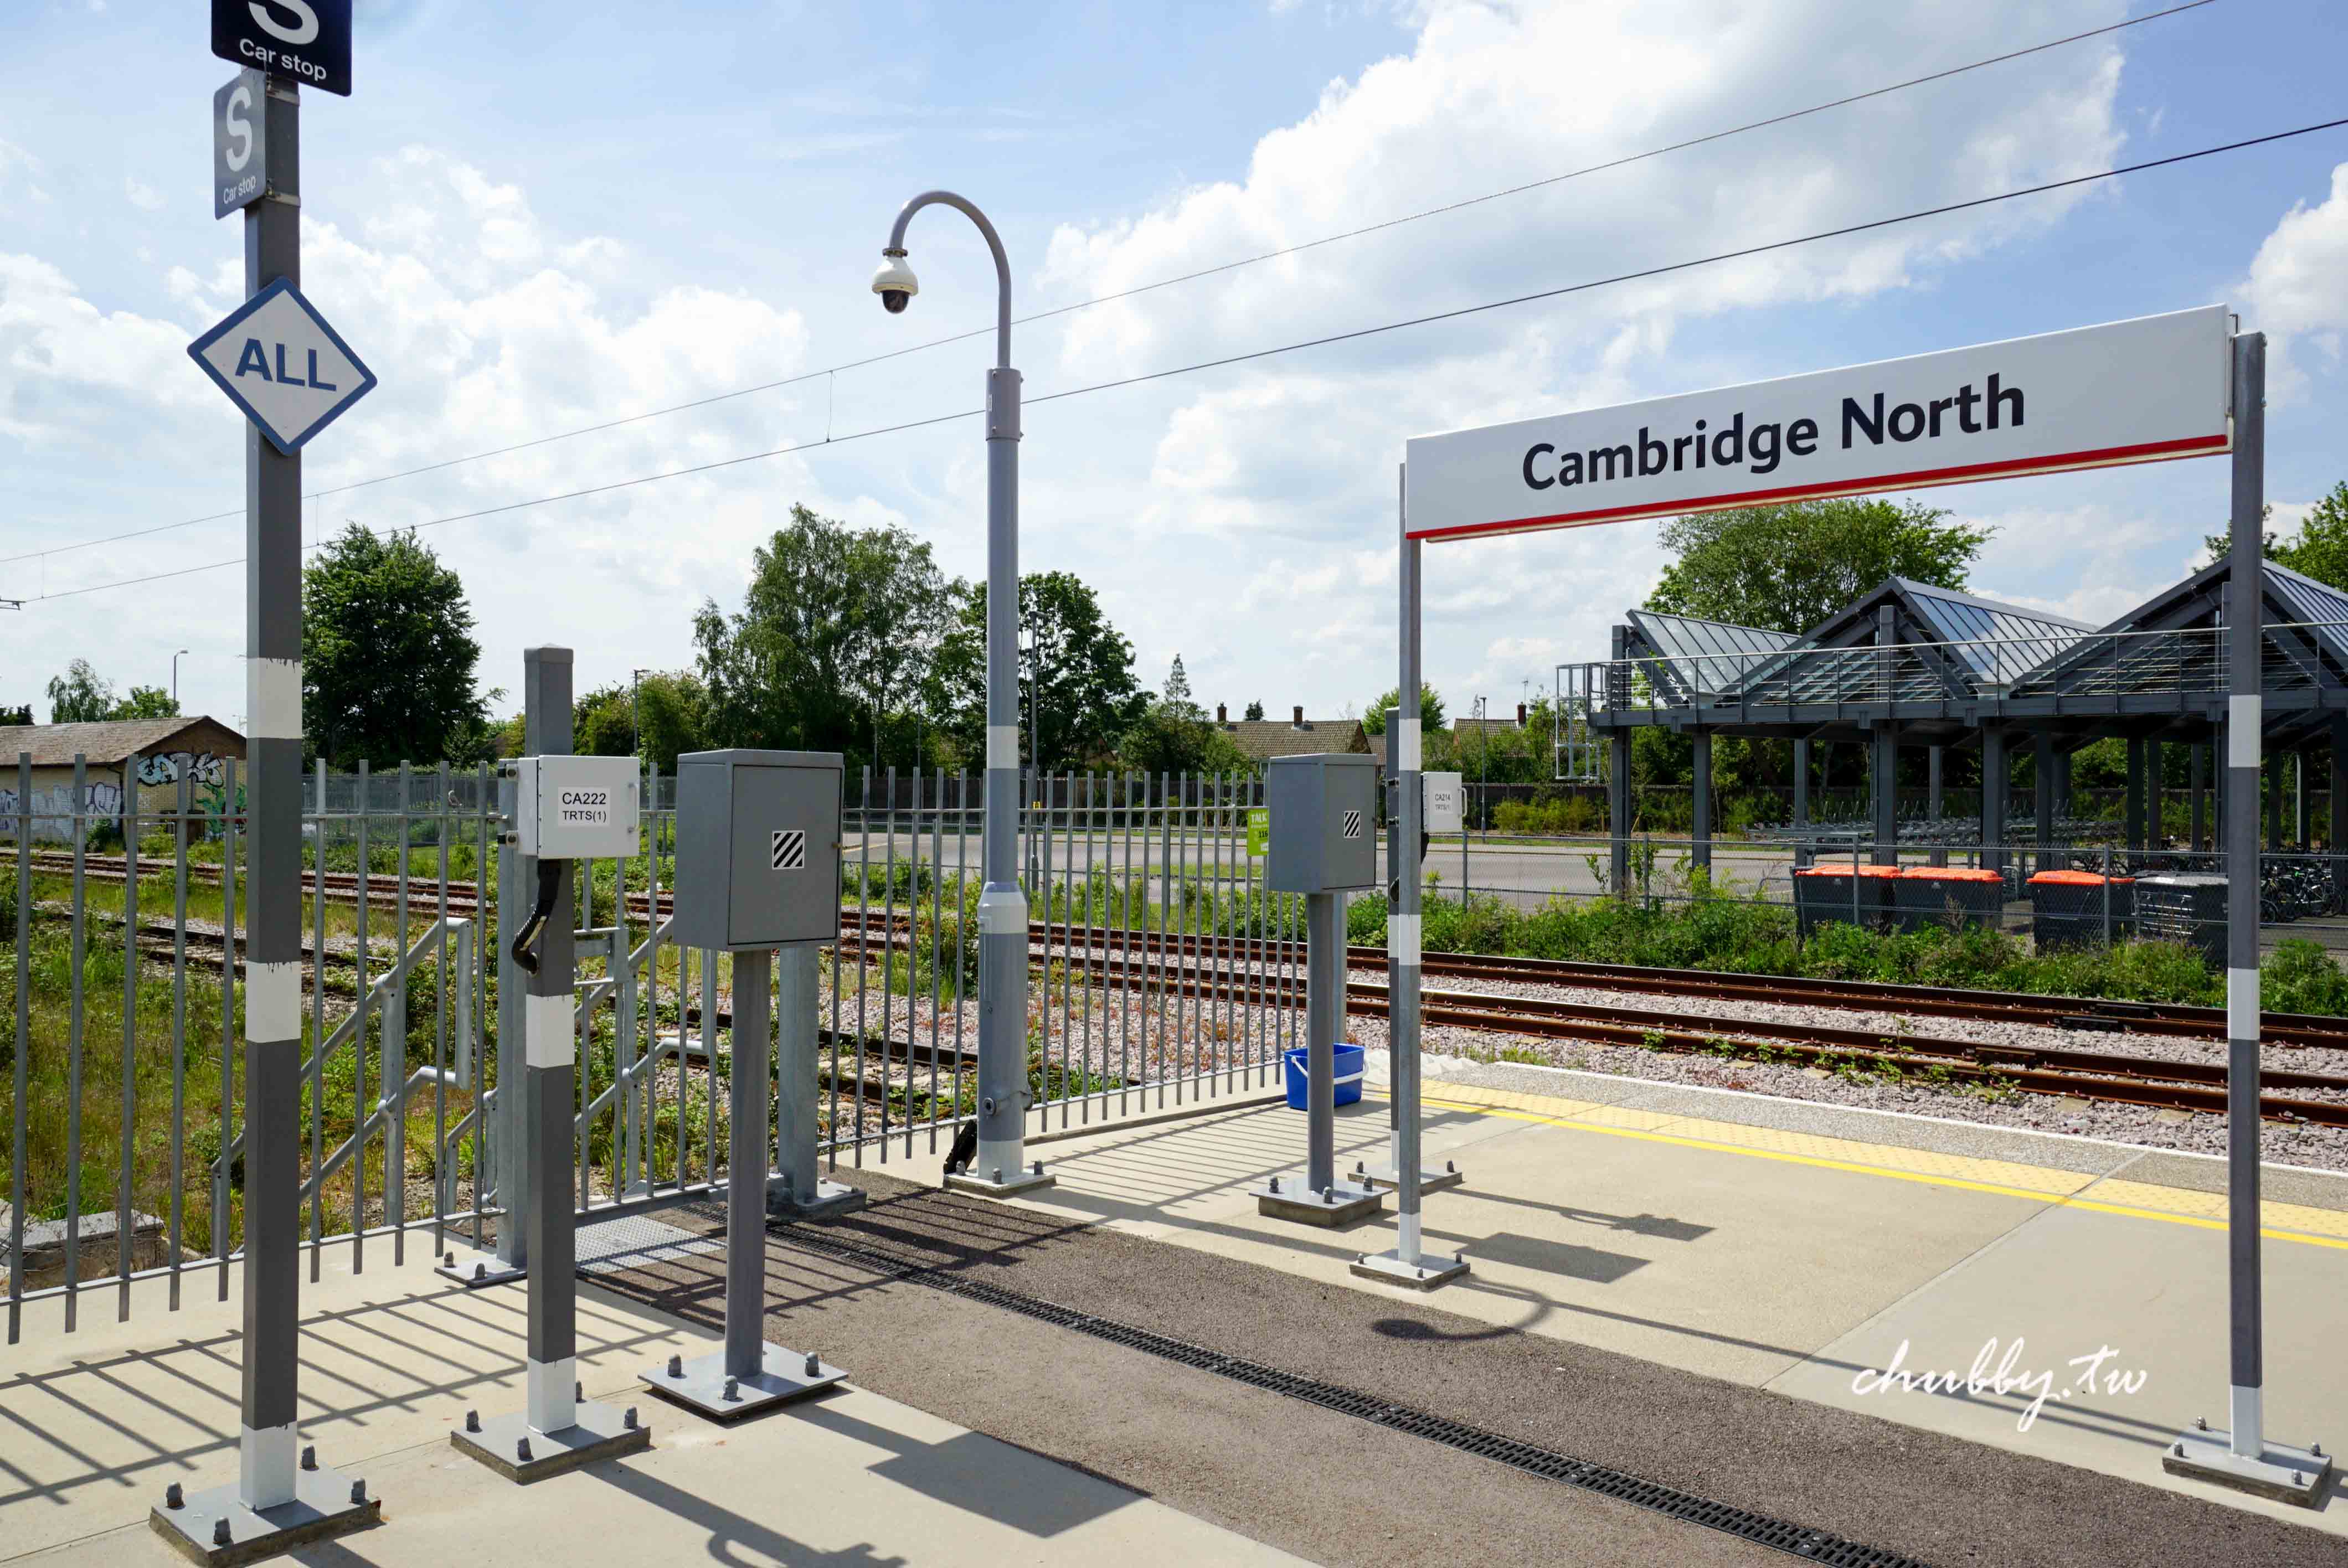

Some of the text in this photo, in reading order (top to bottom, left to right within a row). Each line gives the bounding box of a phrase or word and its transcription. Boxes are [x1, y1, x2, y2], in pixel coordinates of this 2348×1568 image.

[239, 38, 327, 81] Car stop
[226, 86, 253, 172] S
[223, 175, 256, 204] Car stop
[235, 338, 337, 391] ALL
[1522, 372, 2025, 491] Cambridge North
[562, 792, 606, 805] CA222
[562, 810, 606, 823] TRTS(1)
